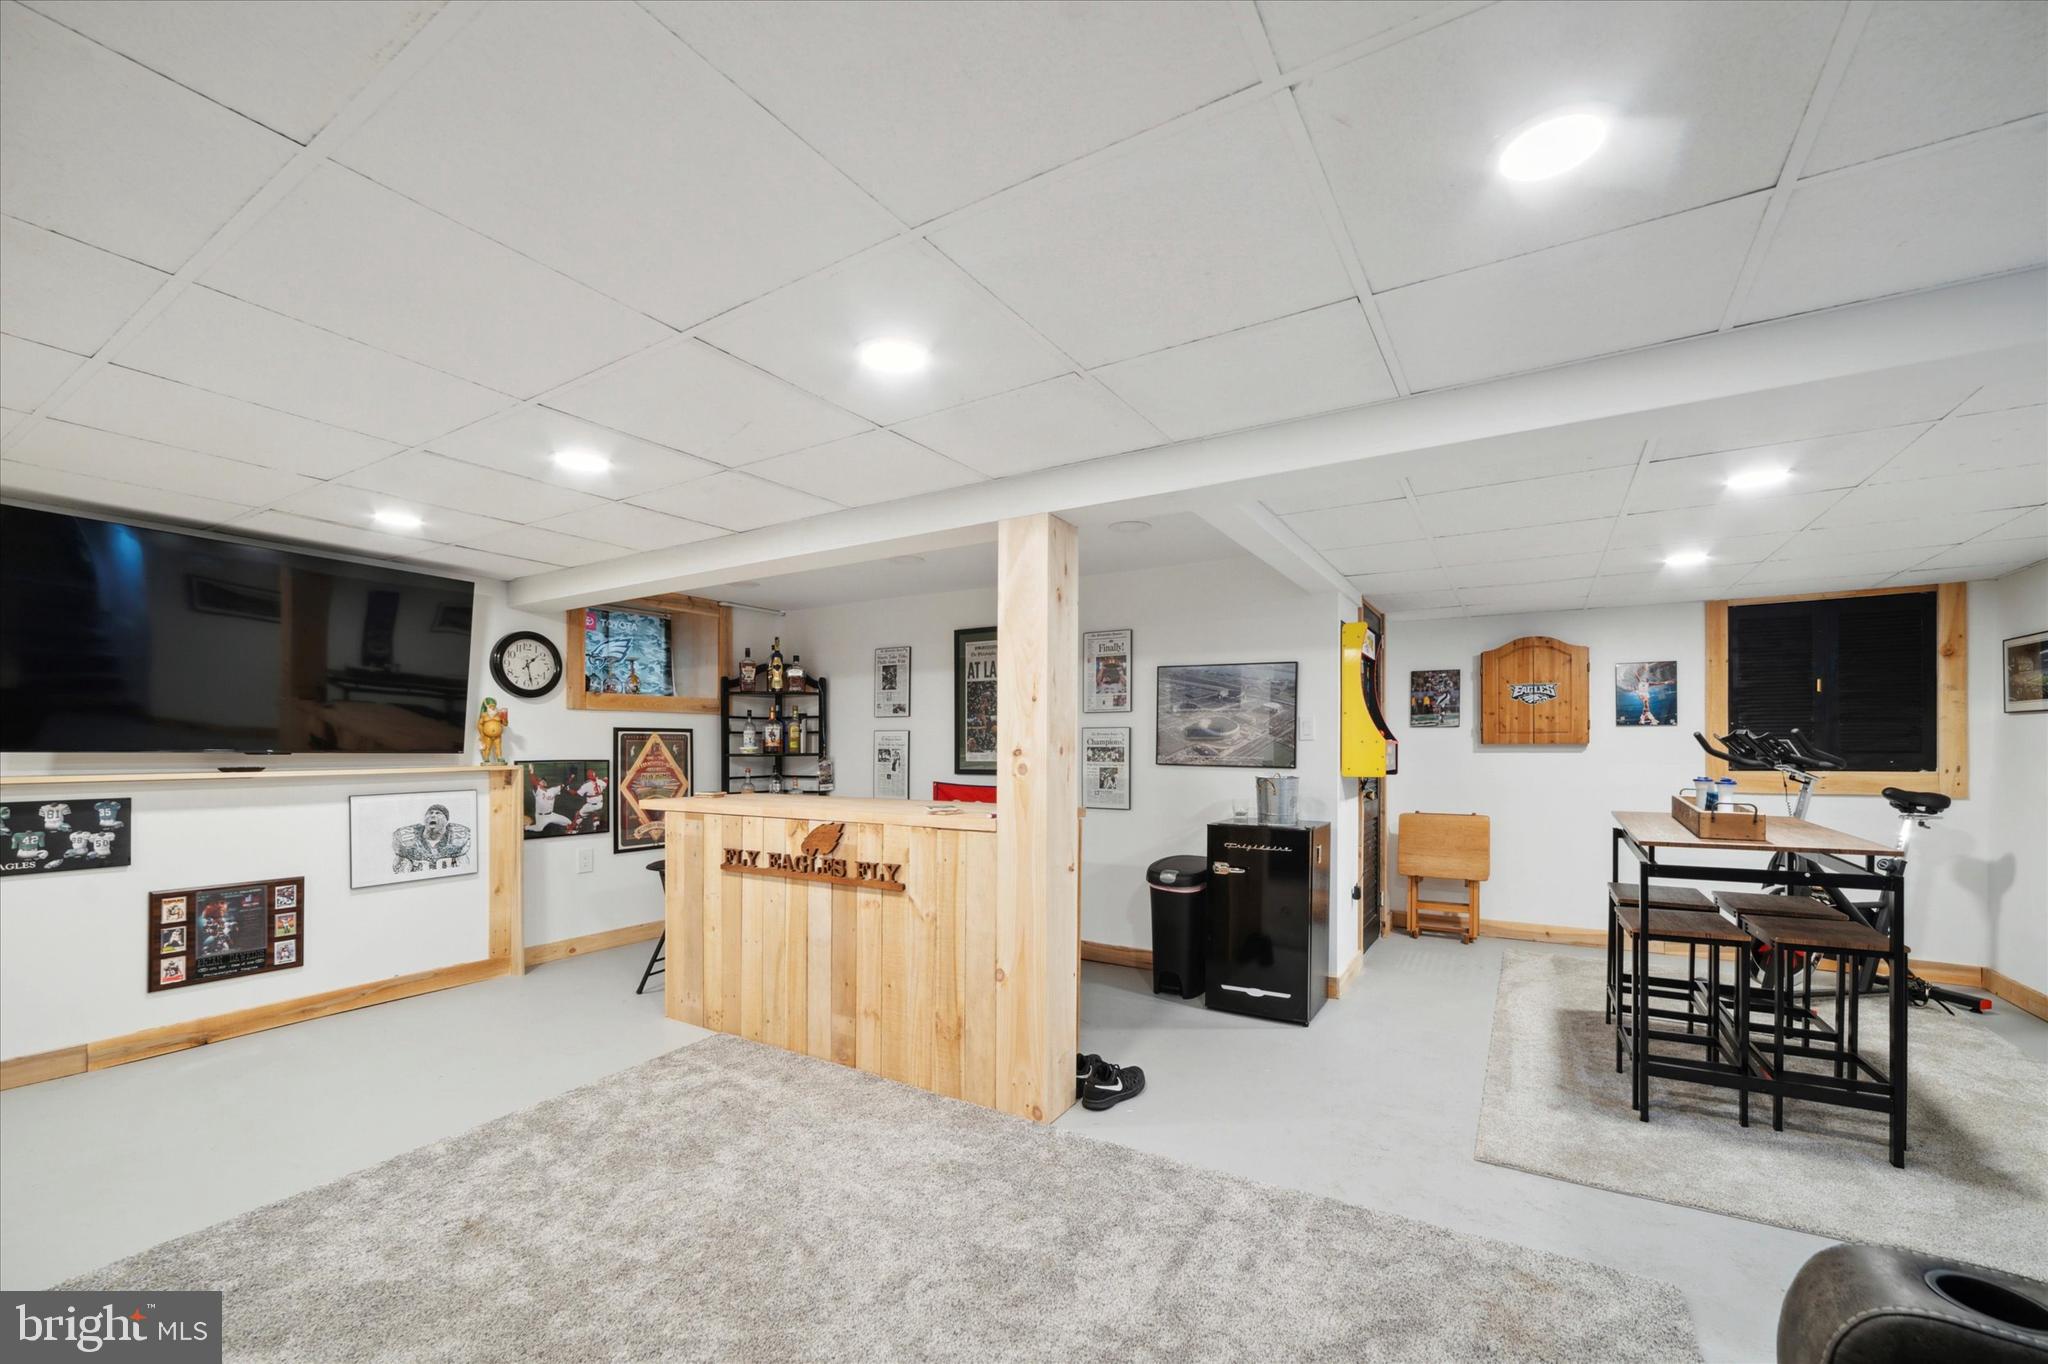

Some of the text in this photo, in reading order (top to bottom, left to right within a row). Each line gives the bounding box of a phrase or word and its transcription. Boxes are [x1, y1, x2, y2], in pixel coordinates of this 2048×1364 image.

[600, 618, 638, 632] TOYOTA
[1098, 642, 1125, 653] Finally!
[967, 661, 981, 680] AT
[1513, 684, 1556, 698] EAGLES
[47, 810, 60, 819] 81
[22, 835, 39, 845] 42
[723, 848, 902, 883] FLY EAGLES FLY
